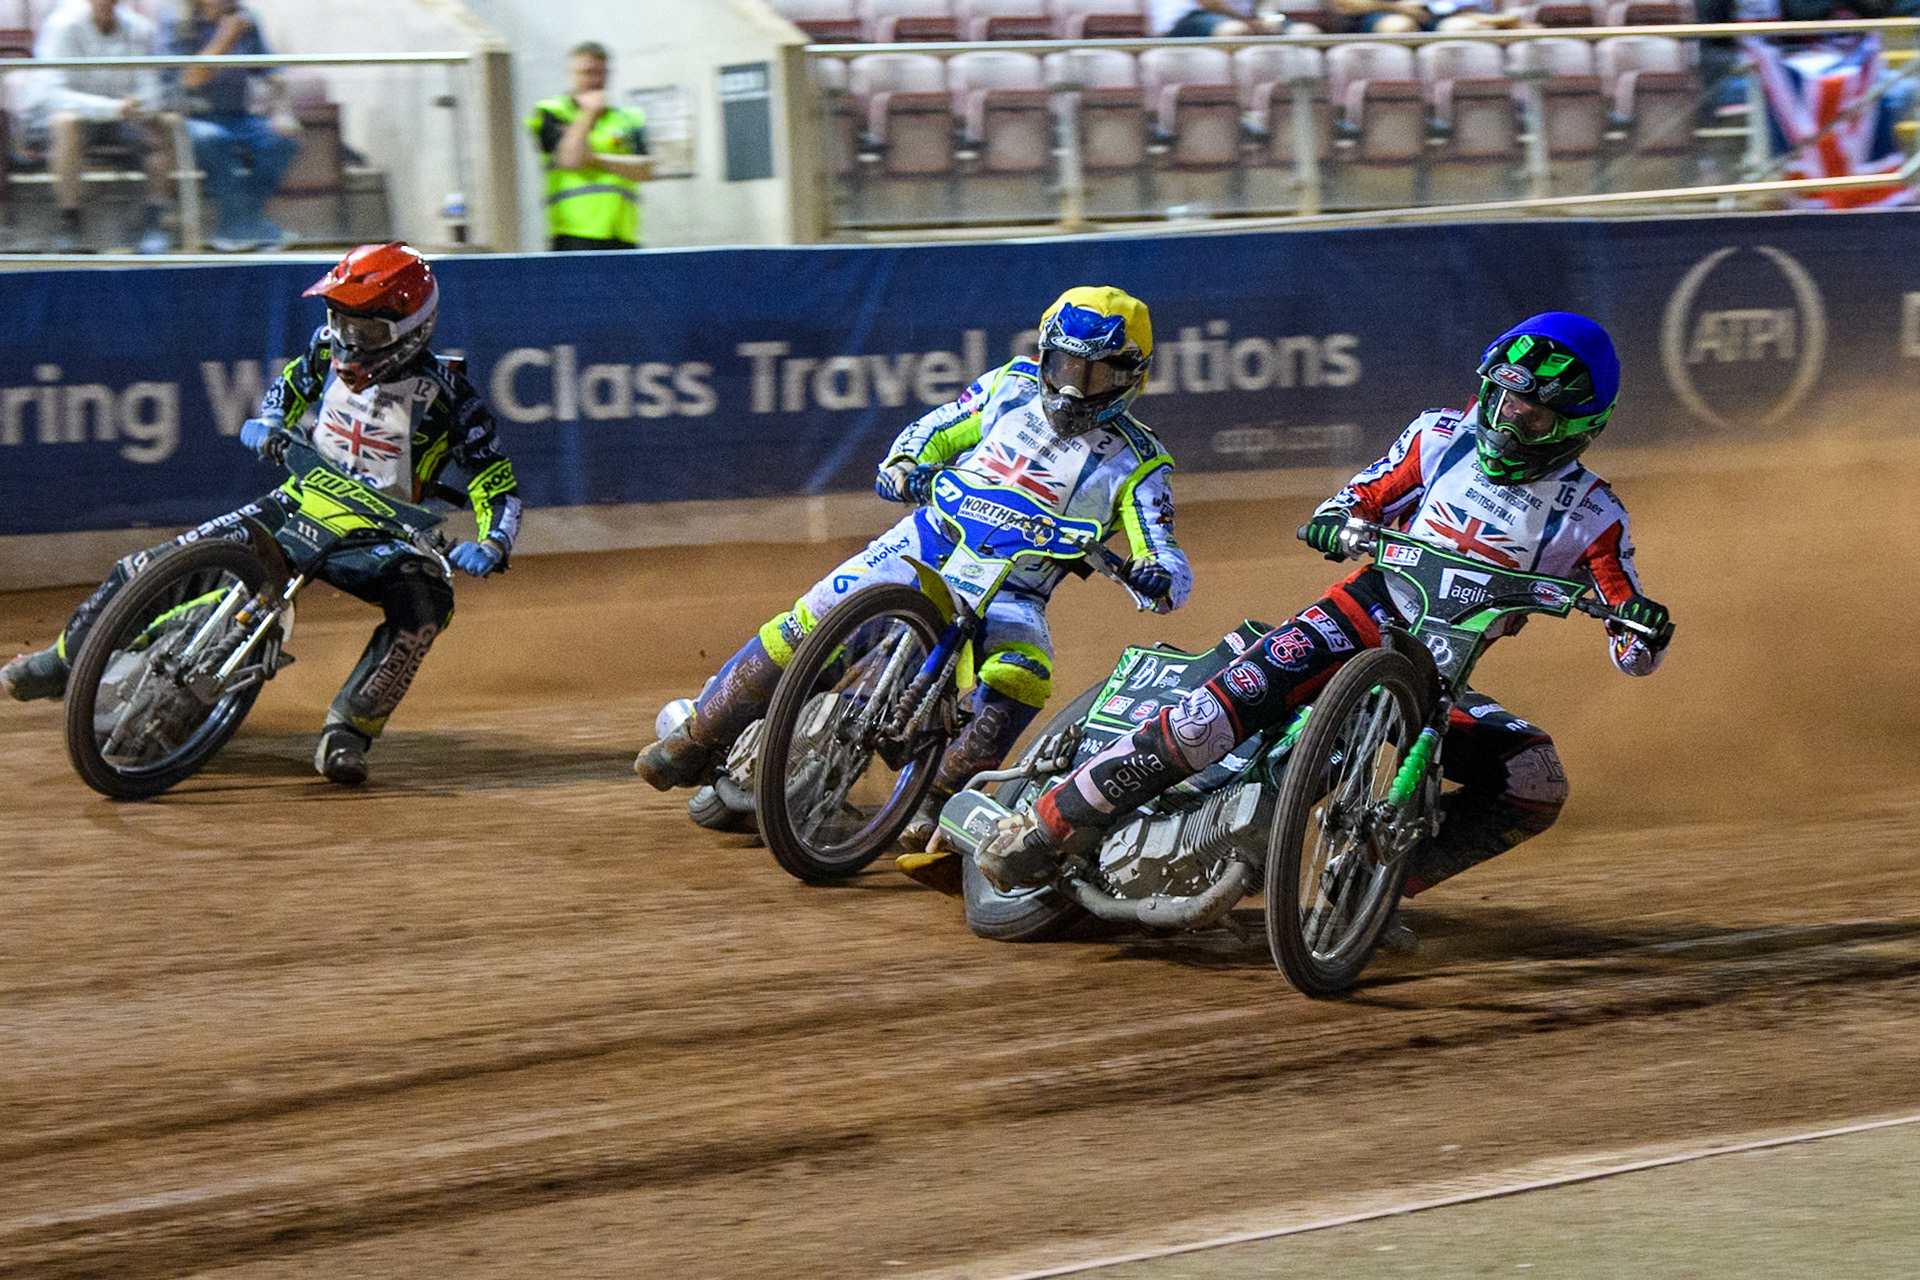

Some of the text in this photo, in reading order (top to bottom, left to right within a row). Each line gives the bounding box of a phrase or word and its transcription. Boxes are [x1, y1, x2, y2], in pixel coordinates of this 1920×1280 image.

[491, 344, 719, 423] Class
[736, 329, 987, 414] Travel
[1010, 319, 1363, 396] utions
[413, 379, 433, 399] 12
[1015, 429, 1042, 450] BRITISH
[1037, 444, 1059, 463] FINAL
[1097, 434, 1113, 450] 2
[935, 477, 964, 503] 37
[1472, 472, 1529, 512] SPORTS DIVISION
[1554, 484, 1577, 509] 16
[1464, 486, 1517, 525] BRITISH FINAL
[1058, 526, 1095, 548] 37
[1397, 545, 1421, 561] FTS
[1318, 618, 1349, 649] FTS
[1233, 668, 1260, 695] STS
[1102, 752, 1167, 800] agilia
